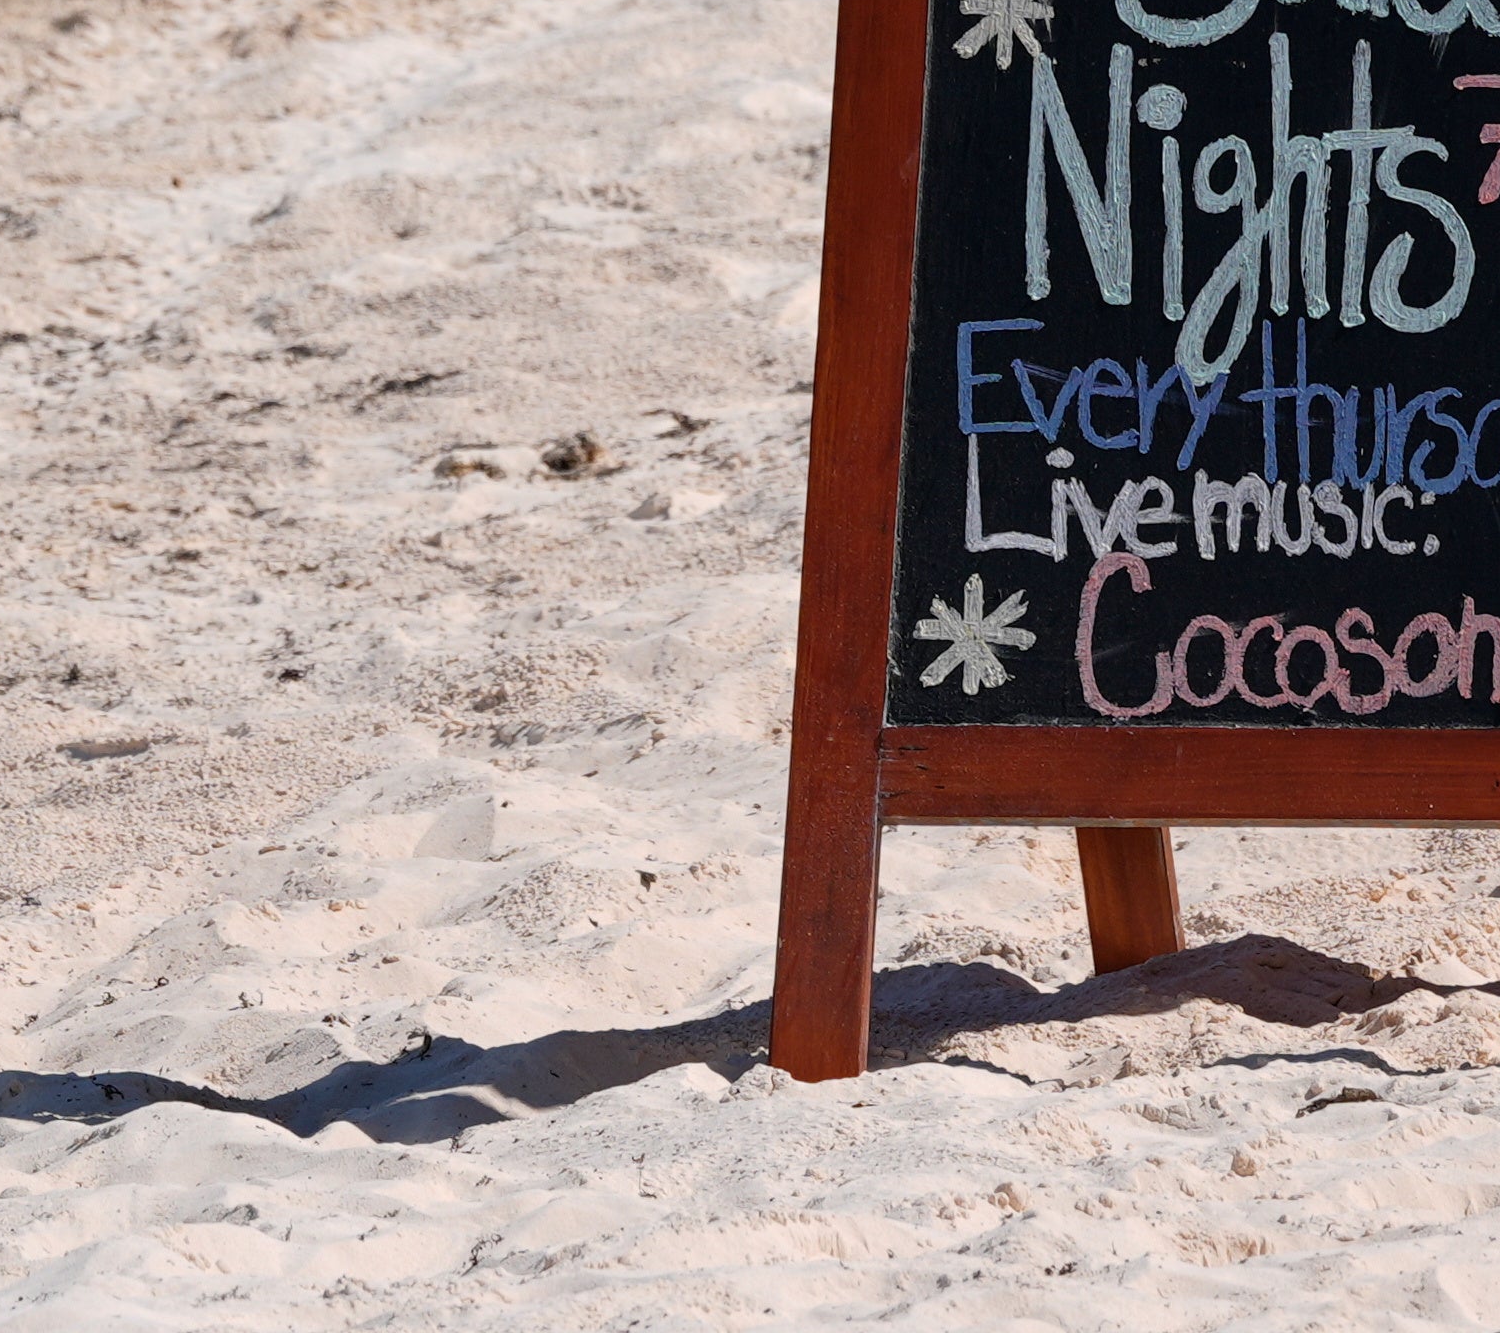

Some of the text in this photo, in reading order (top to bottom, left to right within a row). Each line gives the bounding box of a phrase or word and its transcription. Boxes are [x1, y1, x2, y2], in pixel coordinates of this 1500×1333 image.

[1025, 31, 1477, 384] Nights
[957, 318, 1228, 471] Every
[965, 435, 1178, 563] Live
